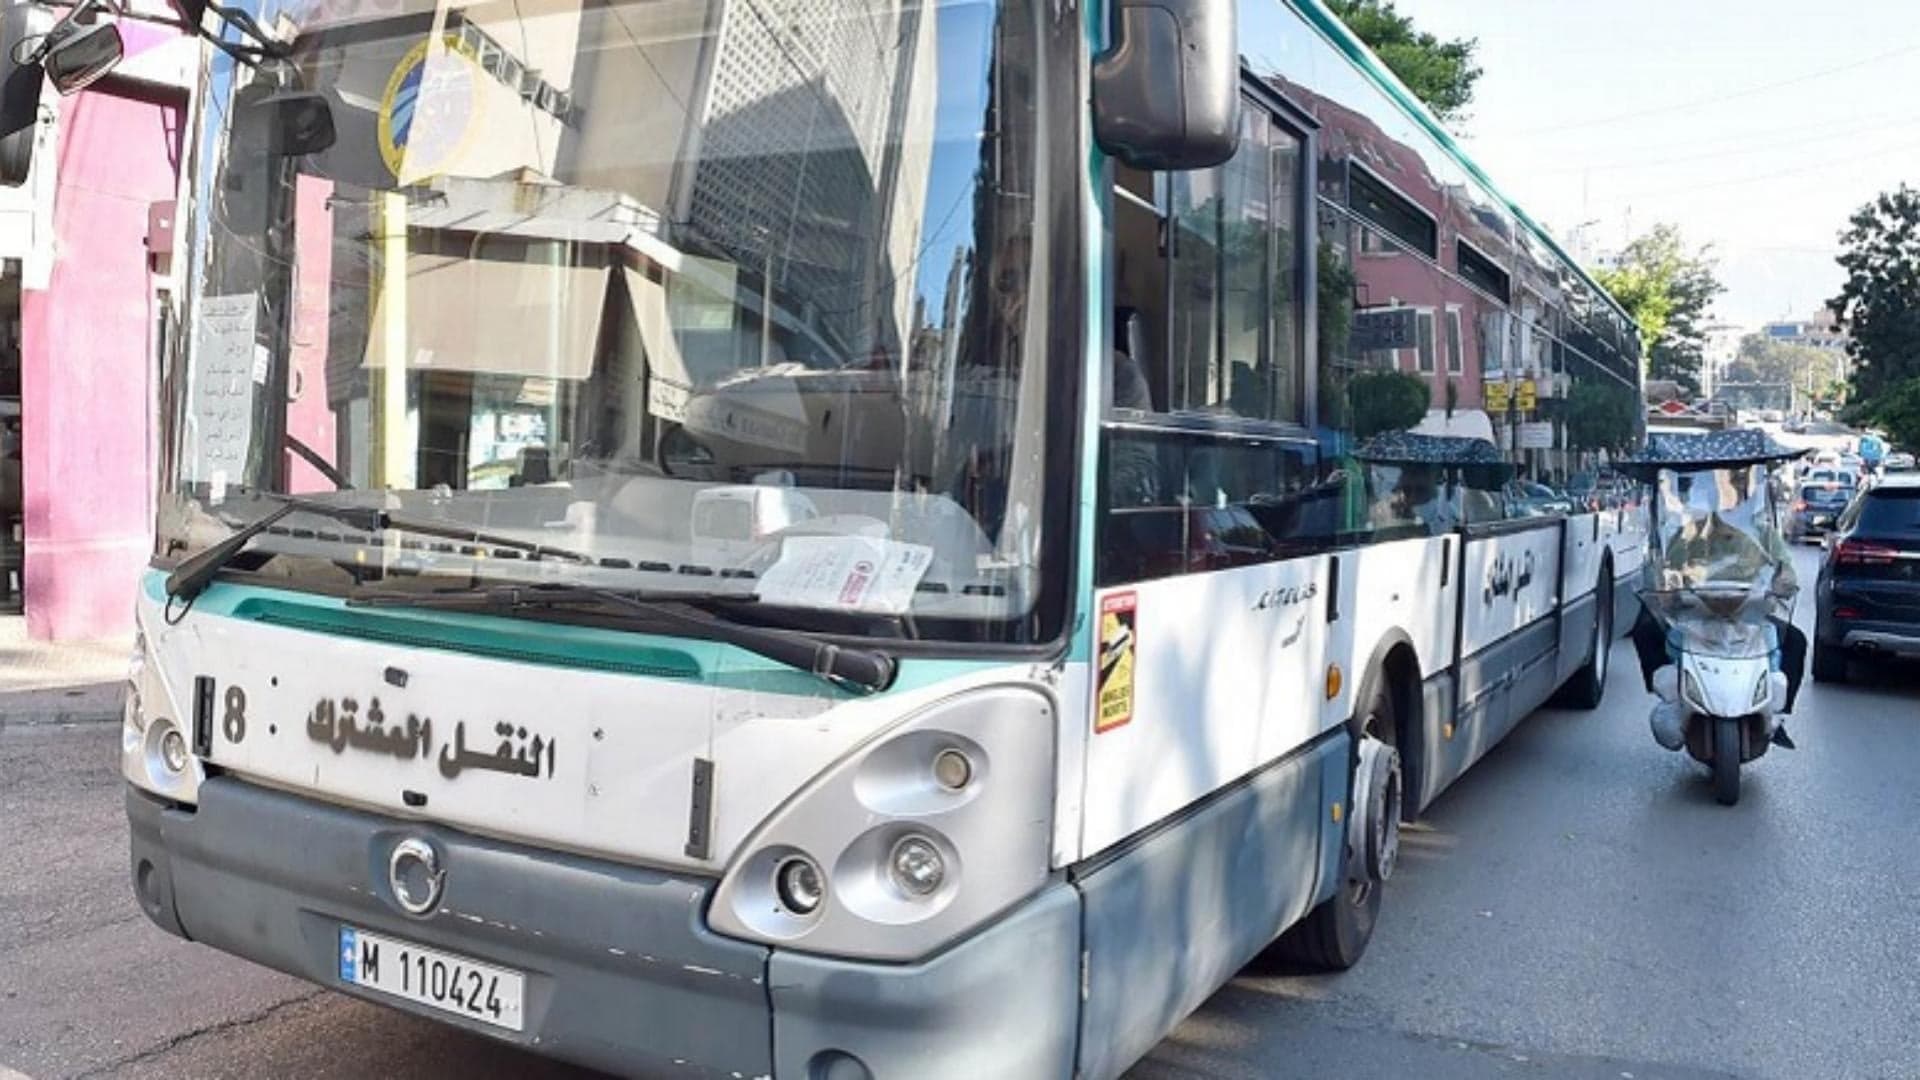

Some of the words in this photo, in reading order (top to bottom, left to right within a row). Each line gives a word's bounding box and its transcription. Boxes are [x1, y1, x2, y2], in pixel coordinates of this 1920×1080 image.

[223, 685, 247, 744] 8
[306, 697, 432, 760] المشترك
[438, 718, 556, 780] النقل
[362, 940, 379, 983] M
[400, 951, 502, 1019] 110424
